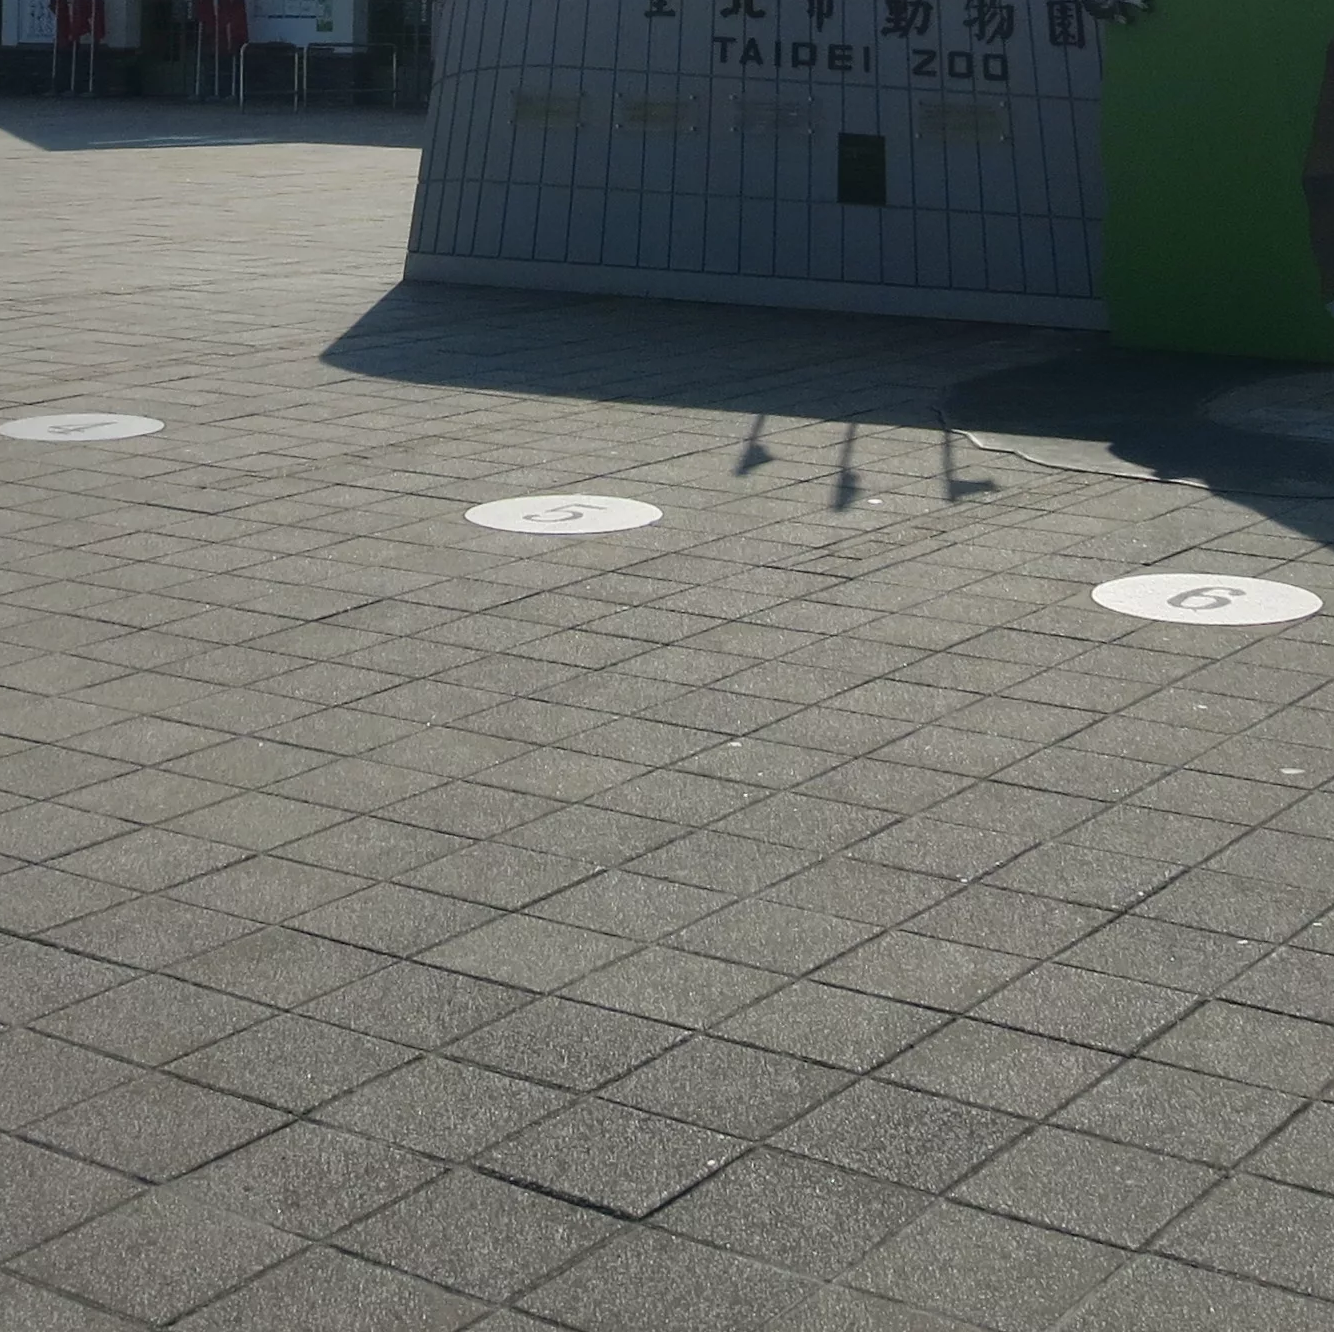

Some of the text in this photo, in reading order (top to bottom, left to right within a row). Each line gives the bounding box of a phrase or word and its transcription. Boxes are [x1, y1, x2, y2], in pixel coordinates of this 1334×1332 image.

[911, 47, 1010, 83] ZOO
[522, 503, 607, 522] 5
[1167, 586, 1247, 611] 6
